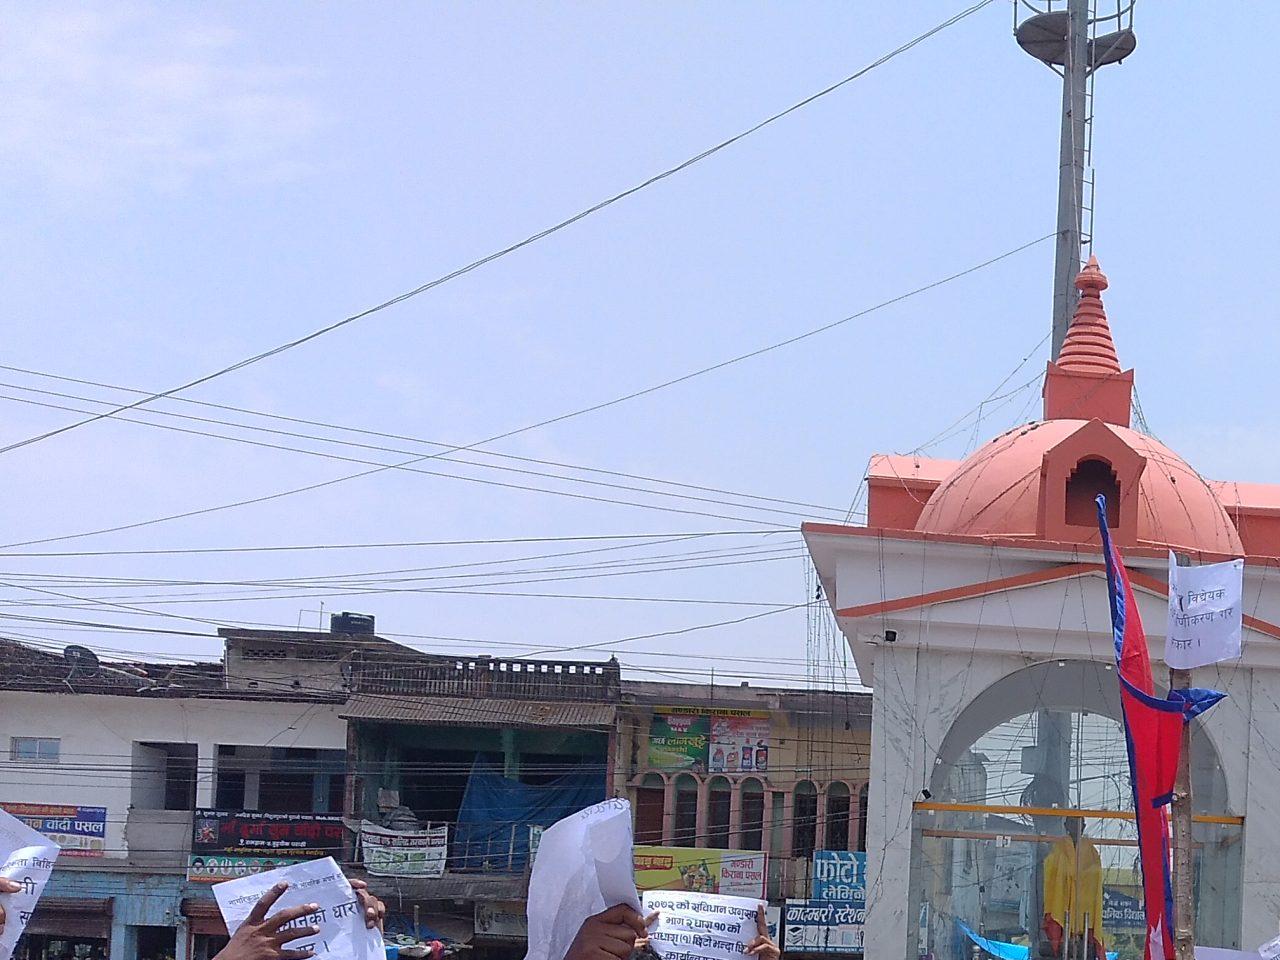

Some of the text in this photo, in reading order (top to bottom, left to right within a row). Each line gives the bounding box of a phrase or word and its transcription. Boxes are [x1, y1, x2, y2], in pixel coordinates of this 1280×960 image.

[74, 821, 104, 833] पसल
[816, 852, 859, 884] फोटो
[822, 885, 865, 901] लेमिने
[647, 900, 674, 911] २०७२
[835, 903, 866, 924] स्टेशन
